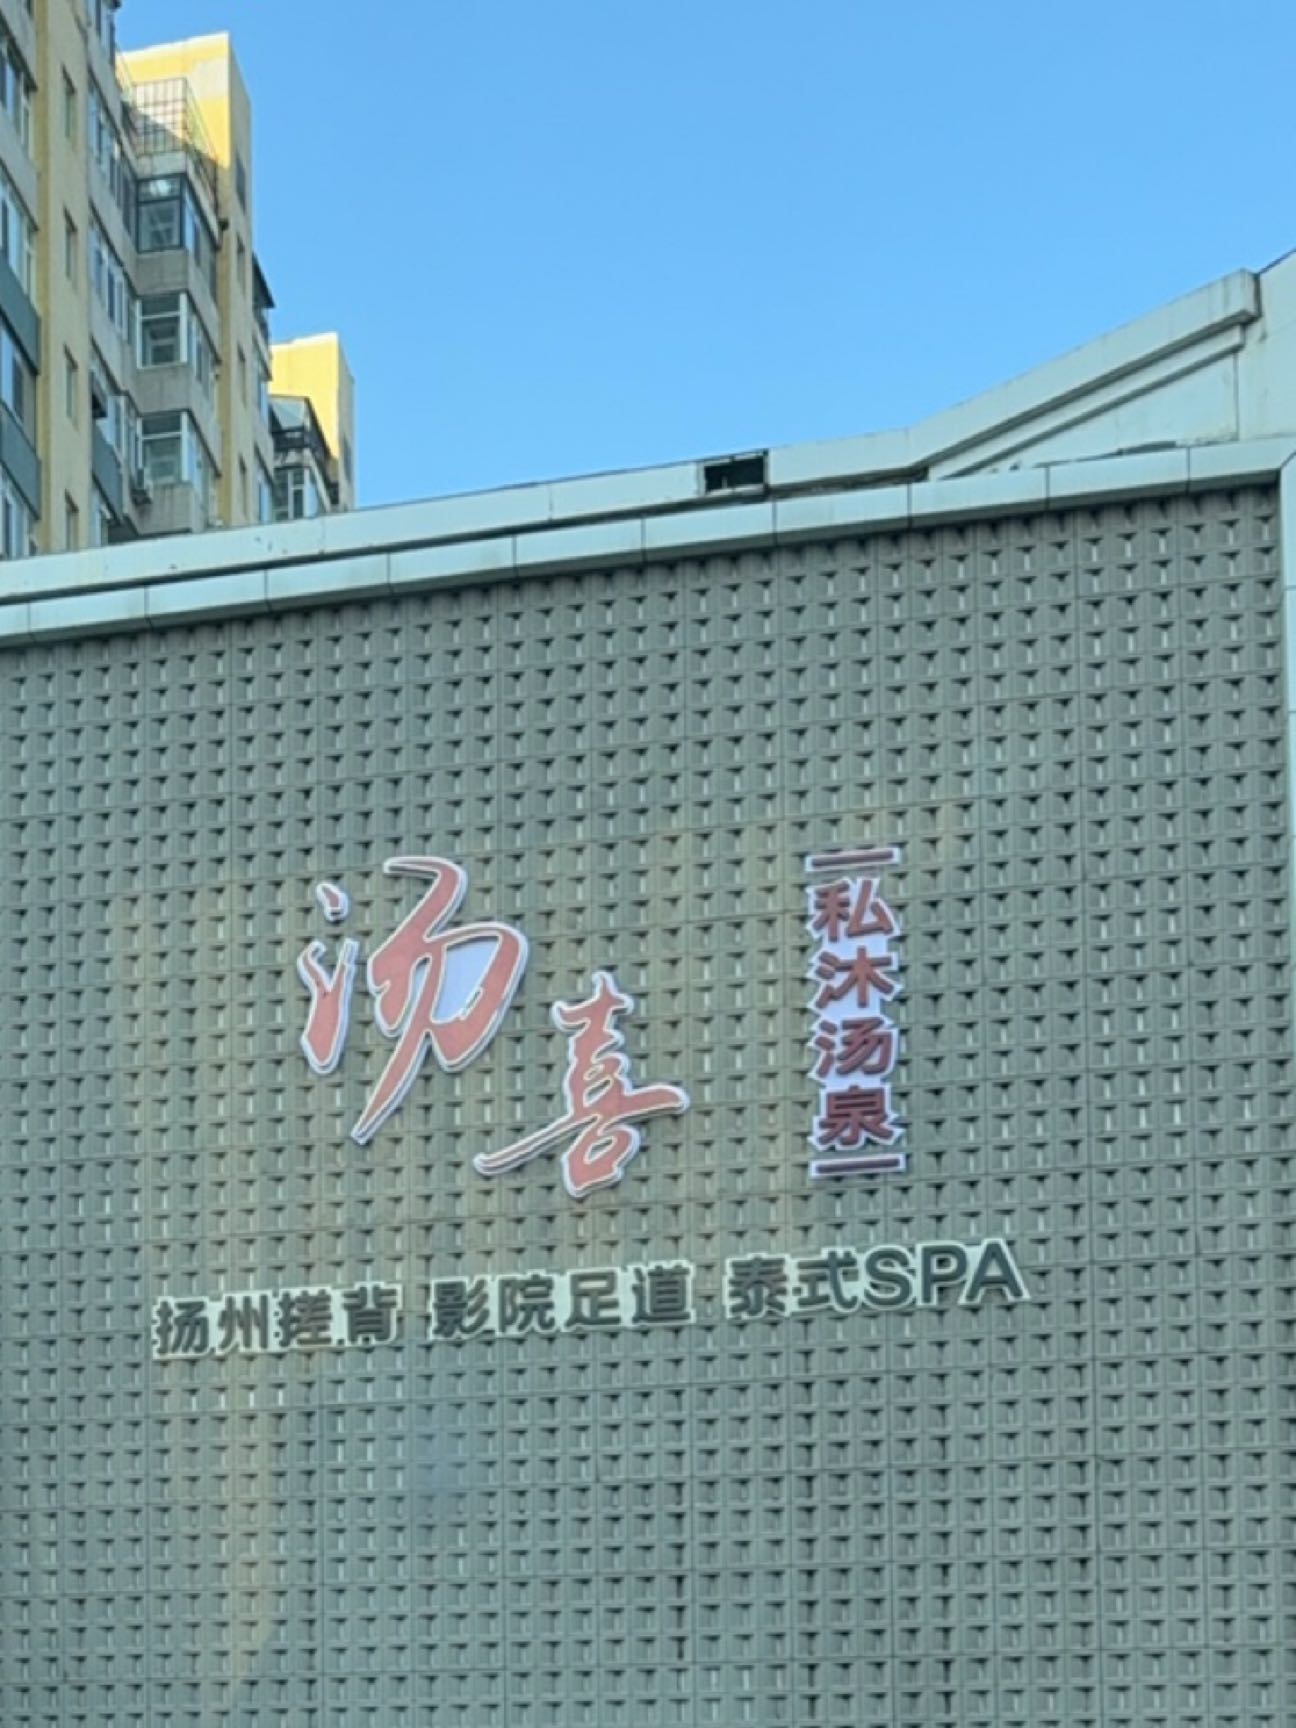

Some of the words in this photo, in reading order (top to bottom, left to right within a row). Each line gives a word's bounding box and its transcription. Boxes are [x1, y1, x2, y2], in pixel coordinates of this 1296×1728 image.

[811, 878, 896, 1146] 私沐汤泉
[154, 1284, 399, 1356] 扬州搓背
[432, 1264, 693, 1338] 影院足道
[728, 1240, 1026, 1318] 泰式SPA
